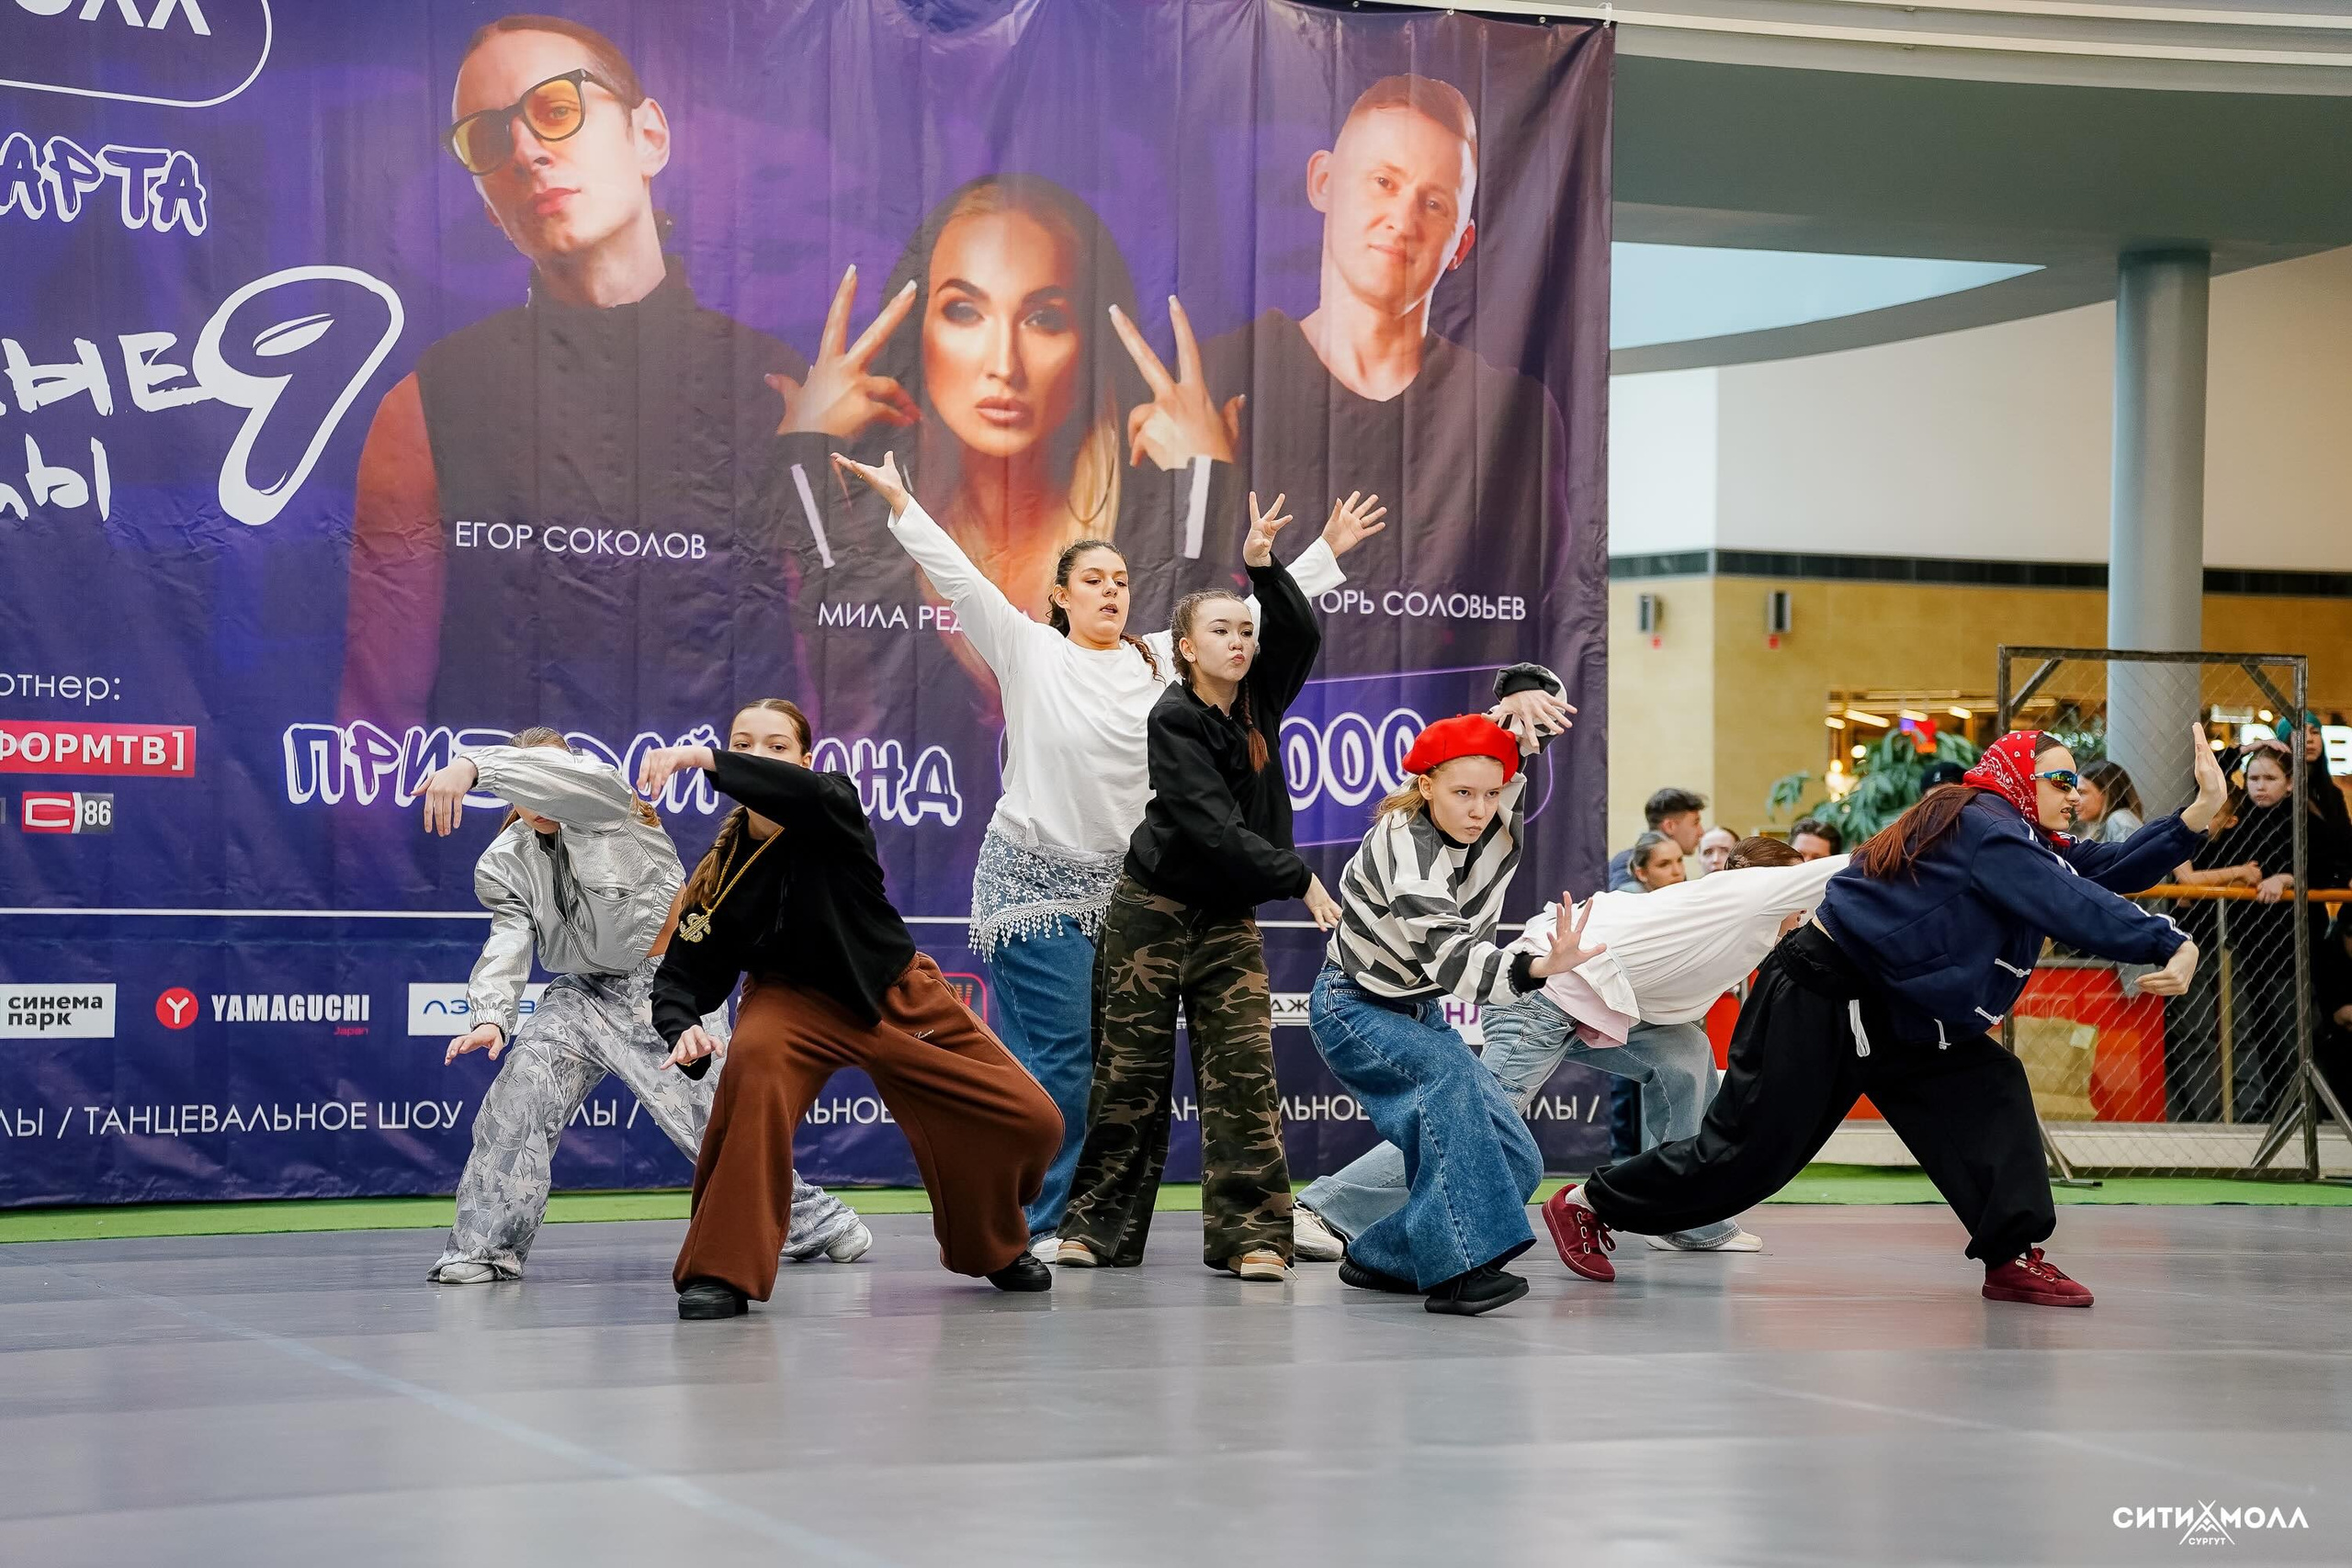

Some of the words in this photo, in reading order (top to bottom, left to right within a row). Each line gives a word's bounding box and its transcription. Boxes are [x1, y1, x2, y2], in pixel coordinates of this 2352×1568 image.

[456, 521, 533, 549] ЕГОР
[544, 525, 707, 559] СОКОЛОВ
[818, 602, 910, 630] МИЛА
[1319, 589, 1374, 615] ОРЬ
[1383, 591, 1526, 620] СОЛОВЬЕВ
[7, 995, 103, 1010] синема
[211, 994, 369, 1022] YAMAGUCHI
[7, 1011, 72, 1031] парк
[334, 1026, 369, 1037] Japan
[84, 1101, 368, 1137] ТАНЦЕВАЛЬНОЕ
[378, 1100, 464, 1131] ШОУ
